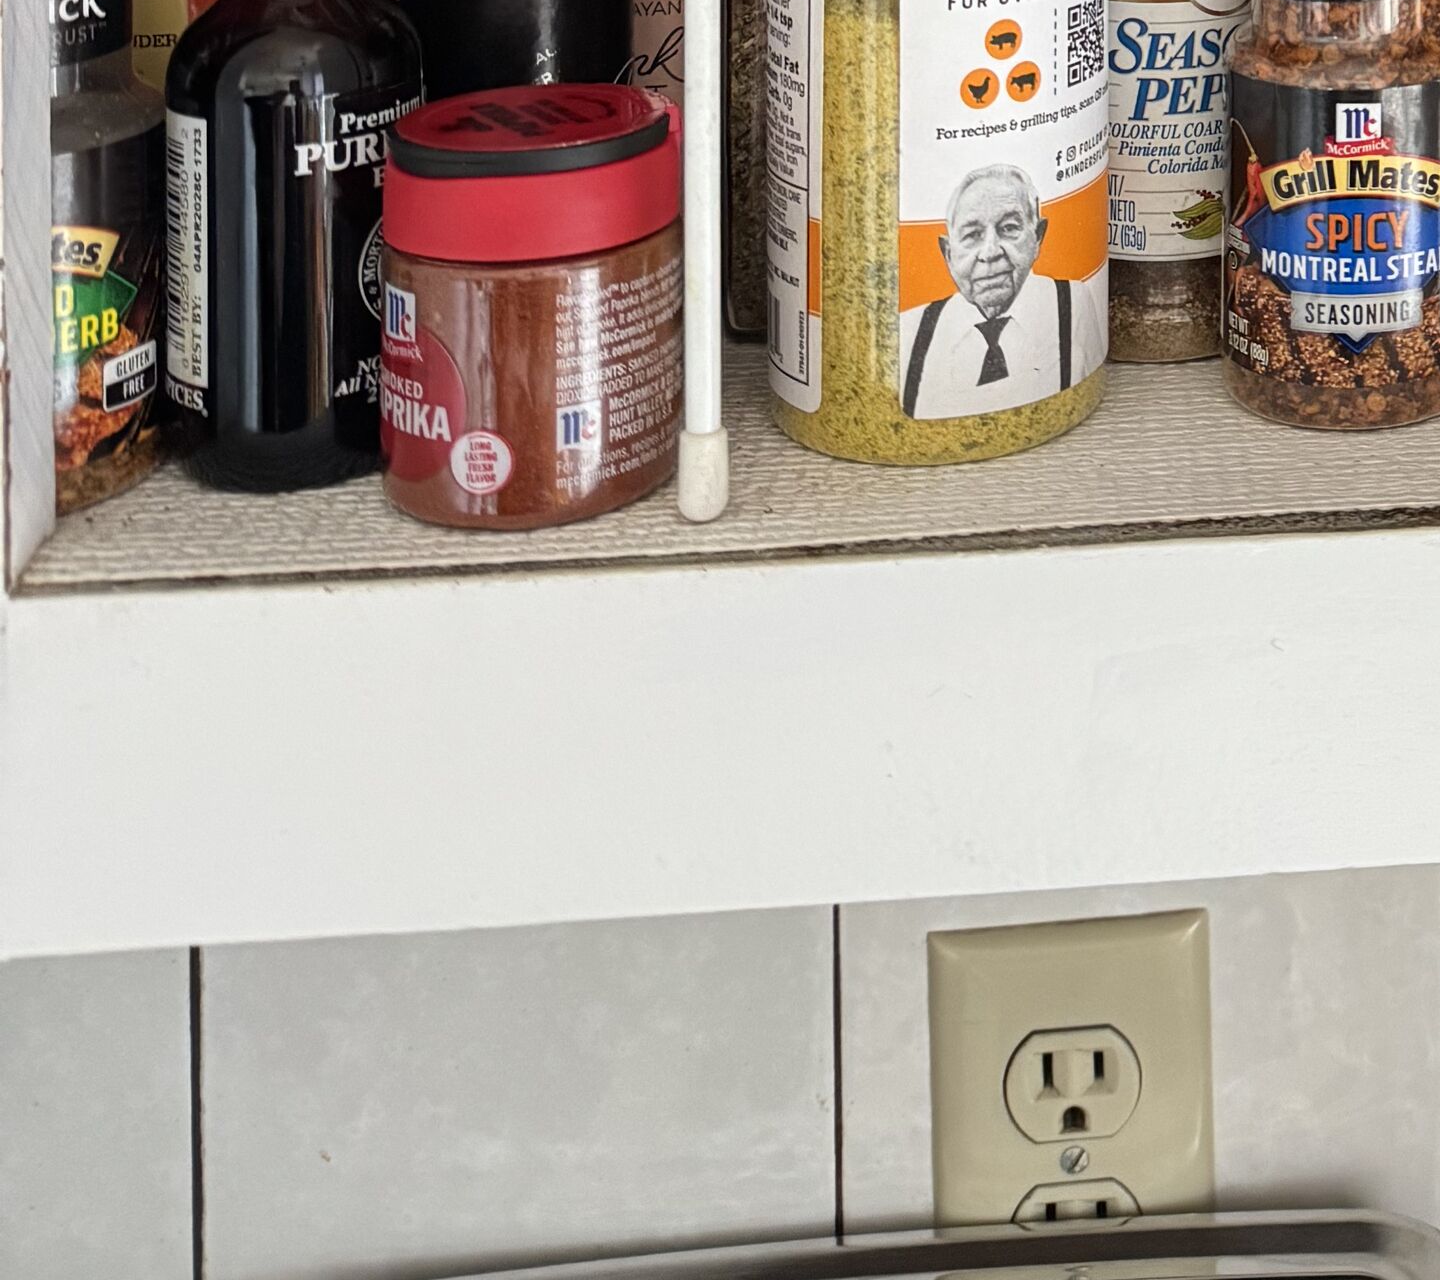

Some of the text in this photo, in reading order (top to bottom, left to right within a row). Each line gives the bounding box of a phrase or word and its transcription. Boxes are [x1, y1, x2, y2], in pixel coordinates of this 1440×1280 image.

[340, 95, 423, 135] Premium
[935, 110, 1058, 143] For recipes grilling
[1118, 139, 1181, 157] Pimienta
[1326, 139, 1388, 156] McCormick
[1147, 156, 1213, 175] Colorida
[1272, 158, 1440, 198] Grill Mates
[1110, 200, 1136, 223] NETO
[1121, 226, 1147, 251] (63g)
[1305, 211, 1410, 253] SPICY
[1261, 247, 1382, 283] MONTREAL
[1305, 299, 1411, 325] SEASONING
[383, 375, 423, 399] MOKED
[382, 392, 451, 442] PRIKA
[464, 451, 498, 462] LASTING
